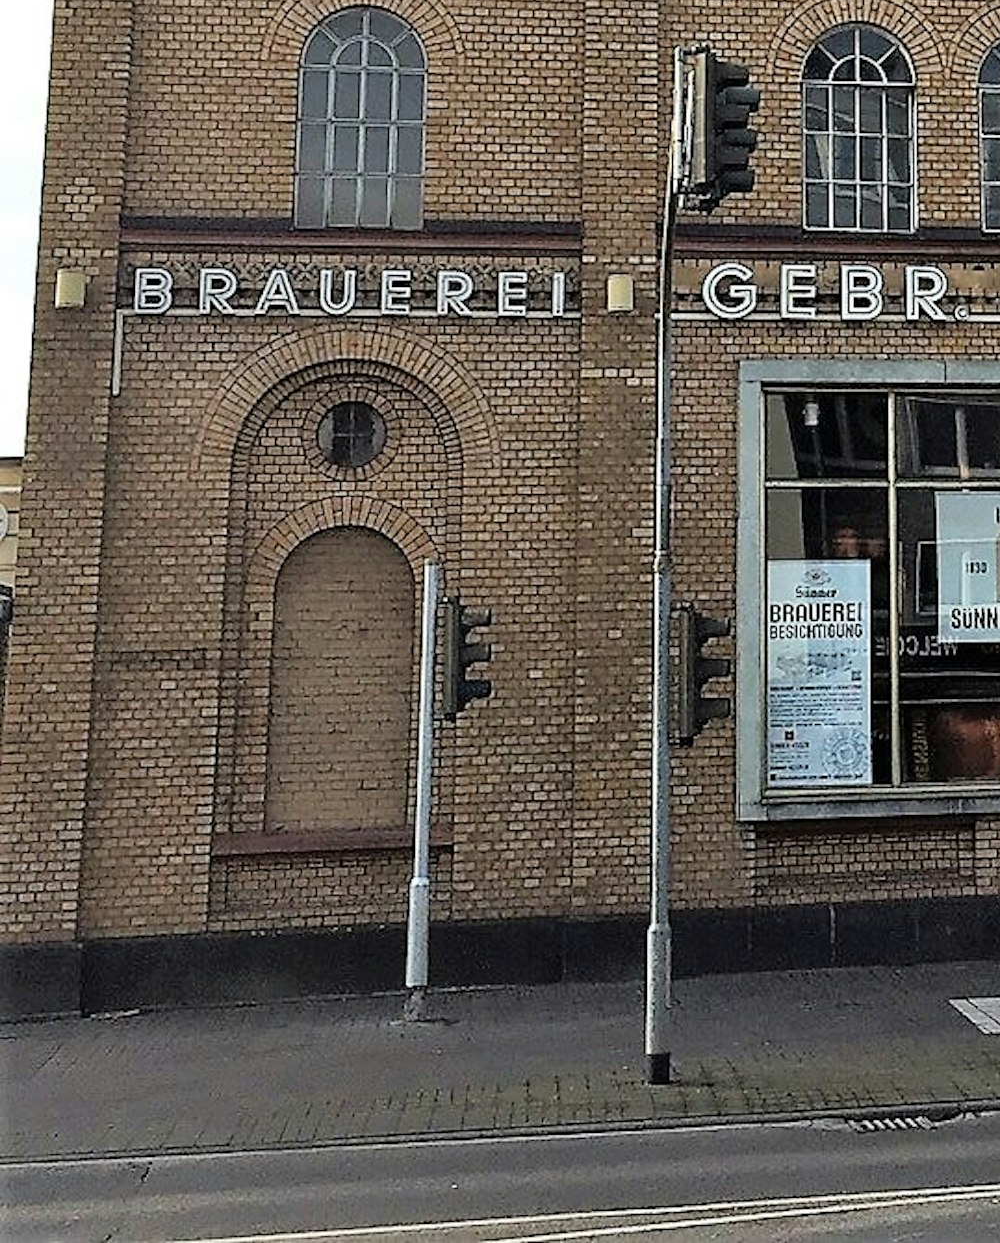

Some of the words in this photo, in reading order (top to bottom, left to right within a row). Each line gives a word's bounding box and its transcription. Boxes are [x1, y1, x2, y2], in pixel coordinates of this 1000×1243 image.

[134, 267, 564, 316] BRAUEREI
[702, 263, 970, 321] GEBR.
[770, 602, 862, 622] BRAUEREI
[769, 623, 863, 639] BESICHTIGUNG
